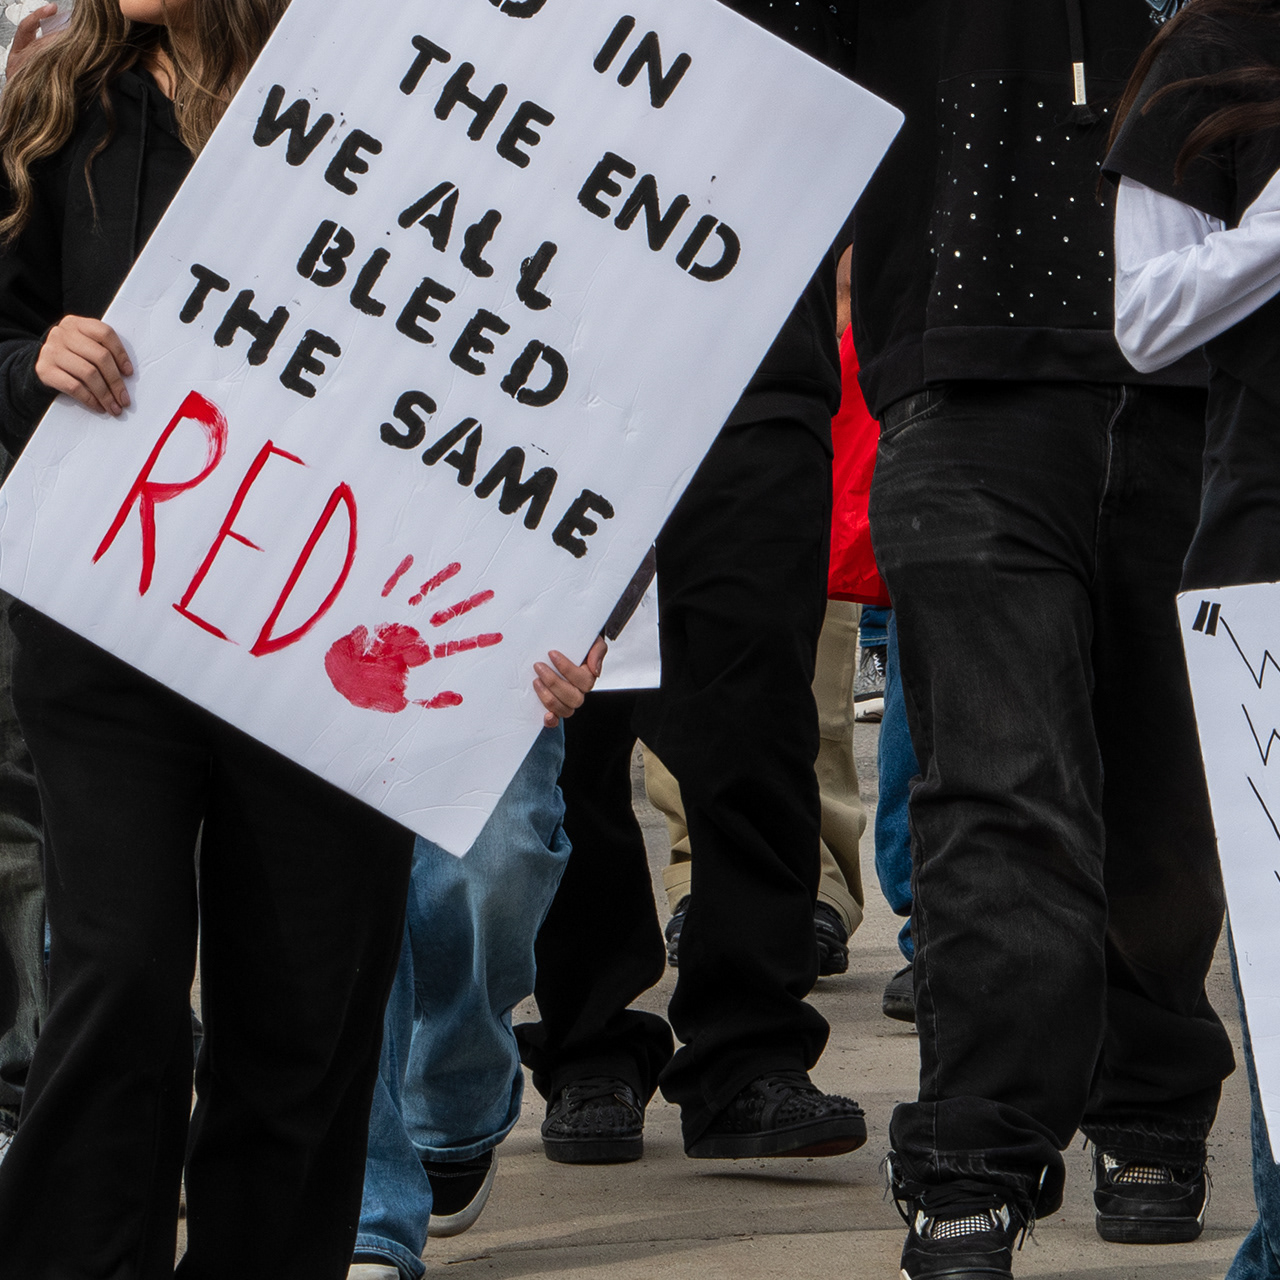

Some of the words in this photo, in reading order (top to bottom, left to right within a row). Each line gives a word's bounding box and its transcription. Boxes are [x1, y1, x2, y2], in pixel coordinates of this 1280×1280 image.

[399, 34, 556, 170] THE
[578, 151, 742, 282] END
[594, 15, 692, 109] IN
[252, 84, 384, 196] WE
[398, 181, 558, 310] ALL
[297, 218, 570, 408] BLEED
[91, 390, 358, 659] RED
[178, 264, 343, 399] THE
[380, 391, 616, 559] SAME
